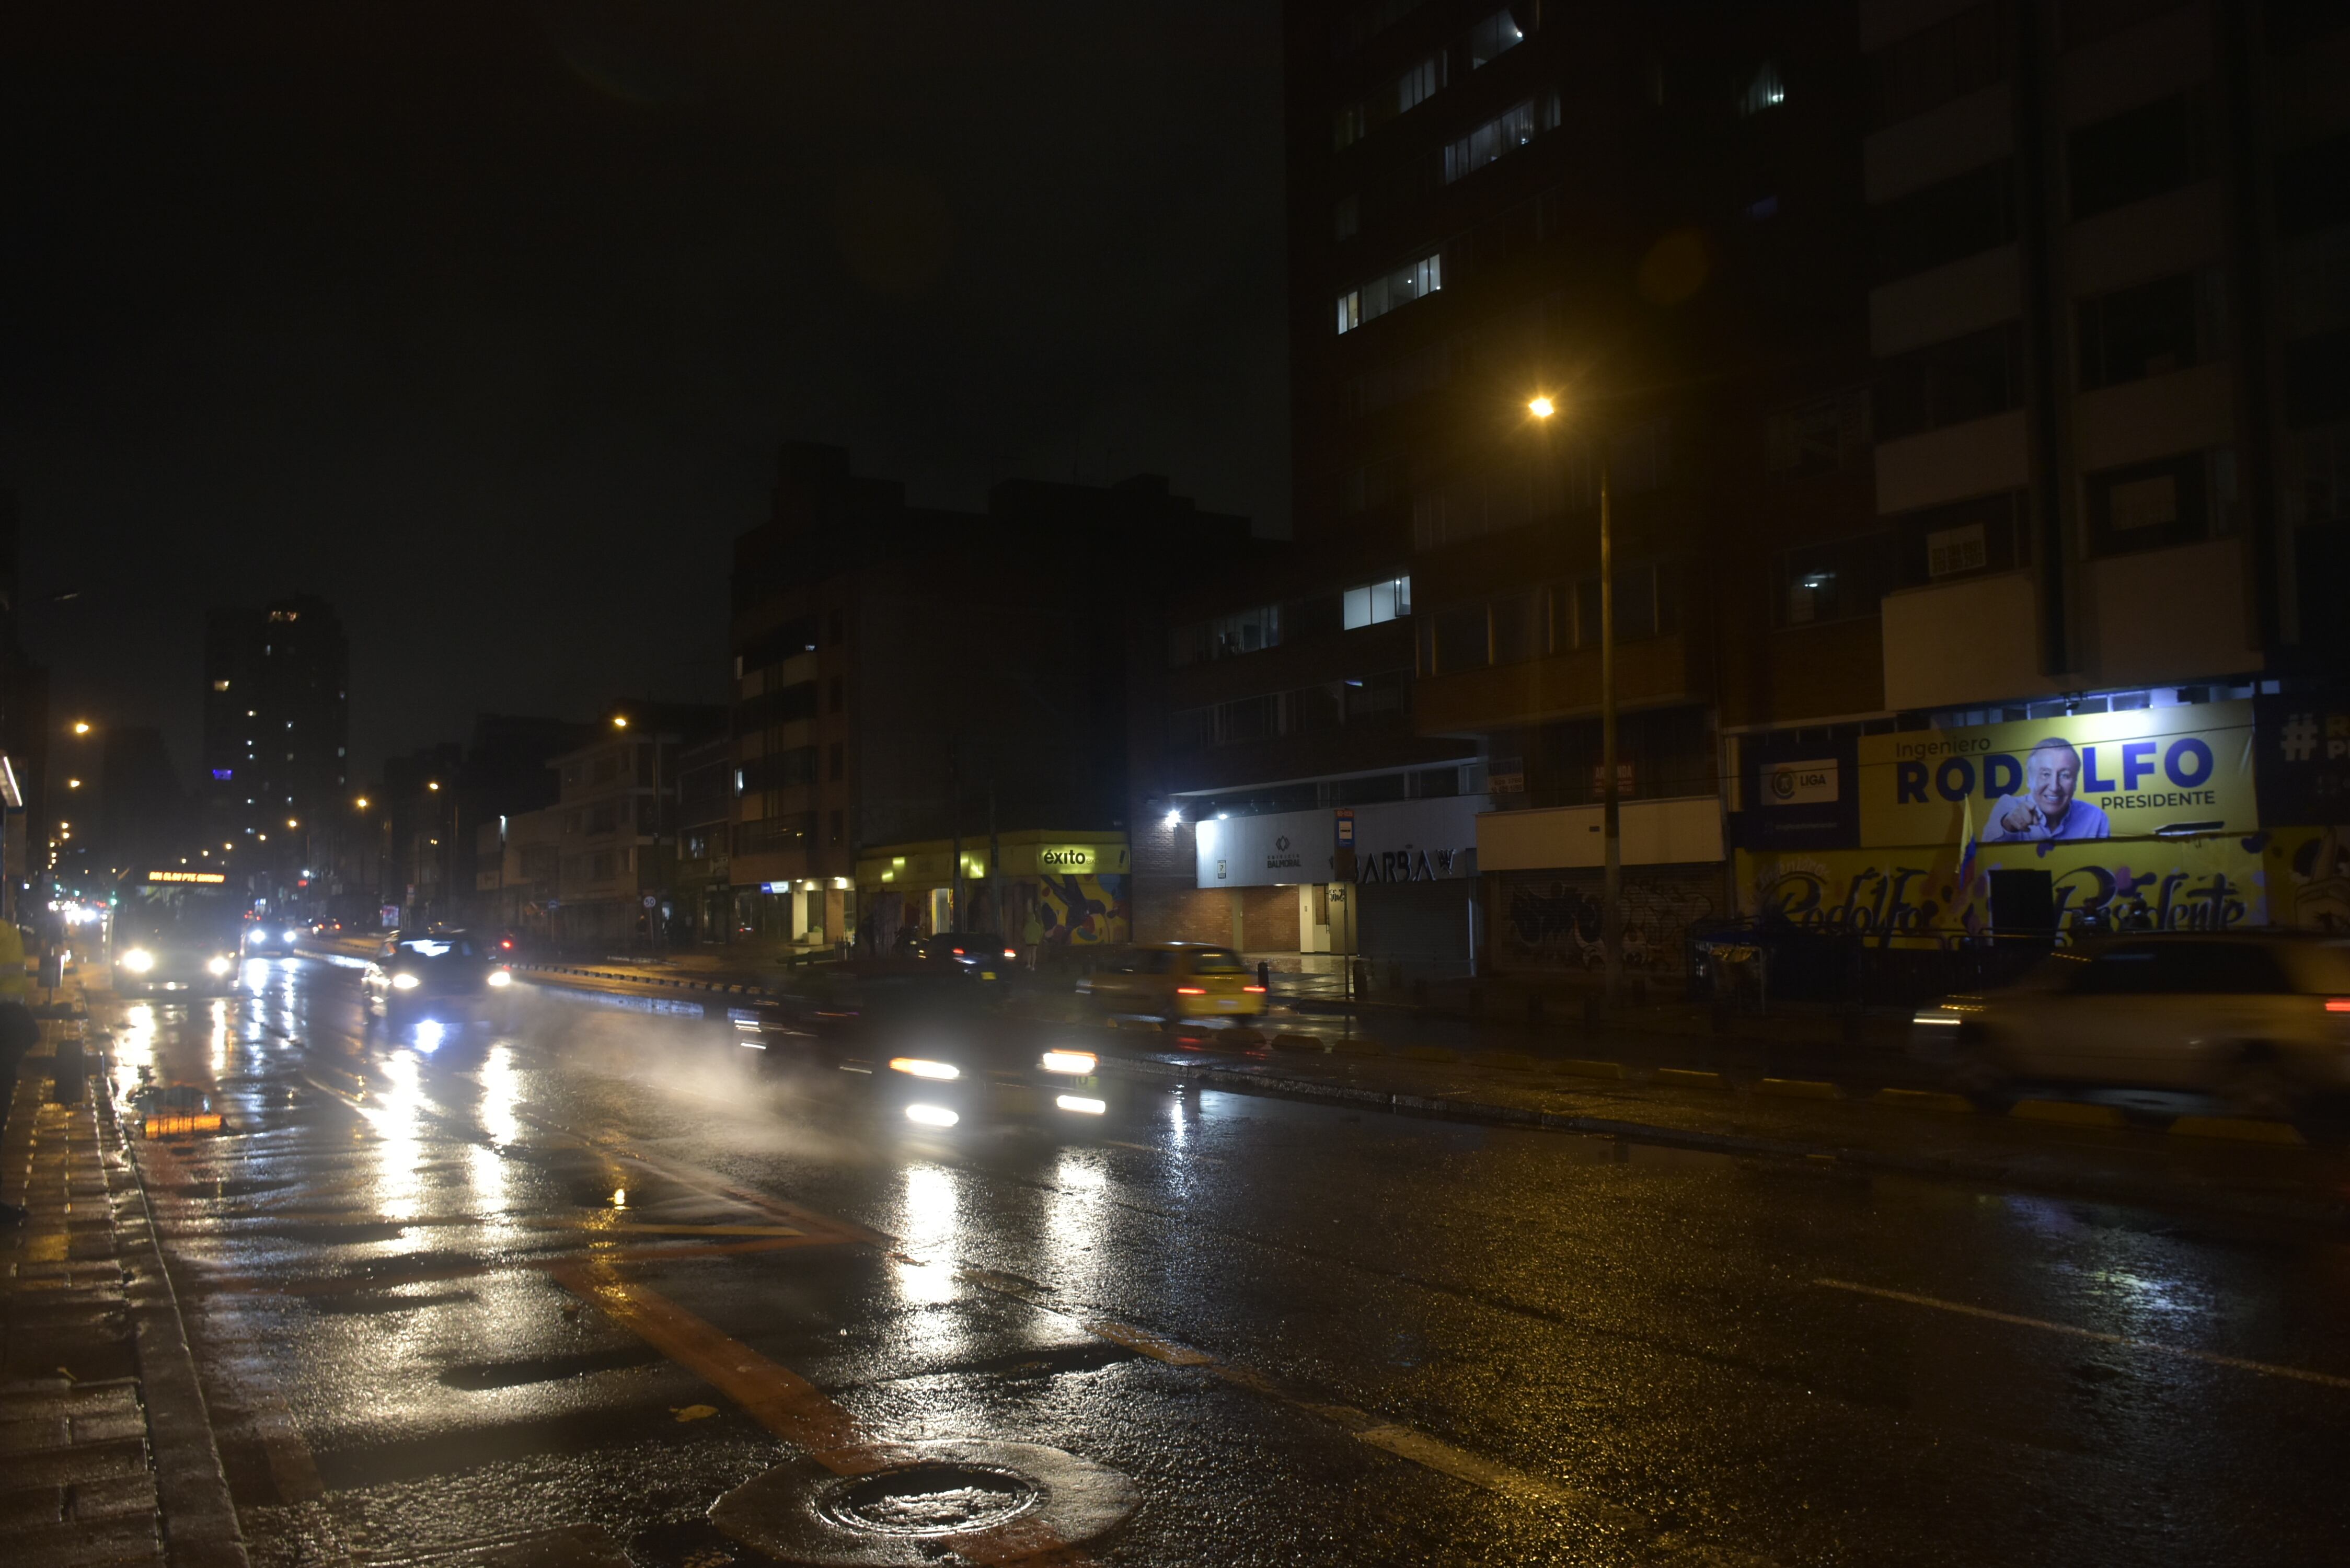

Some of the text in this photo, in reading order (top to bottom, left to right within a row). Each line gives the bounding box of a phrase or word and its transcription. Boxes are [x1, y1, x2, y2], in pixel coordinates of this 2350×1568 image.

[1896, 735, 1991, 760] Ingeniero
[1896, 737, 2214, 804] RODLFO
[1800, 774, 1827, 787] LIGA
[2101, 790, 2216, 810] PRESIDENTE
[1043, 849, 1086, 865] éxito
[1267, 859, 1301, 868] BALMORAL
